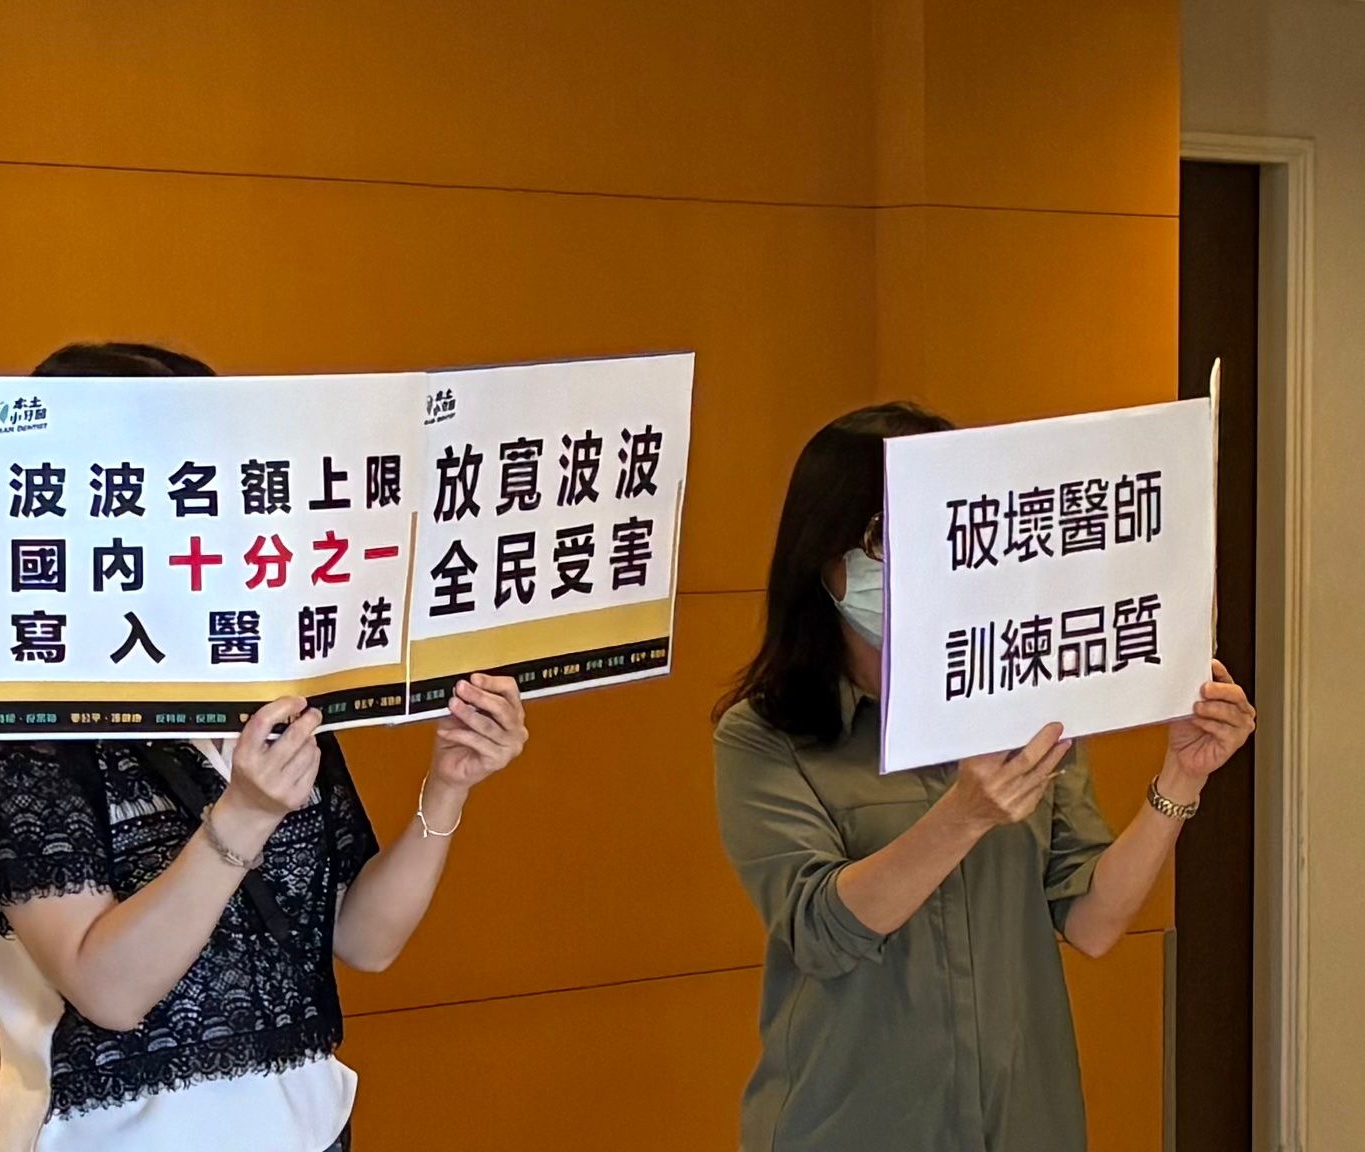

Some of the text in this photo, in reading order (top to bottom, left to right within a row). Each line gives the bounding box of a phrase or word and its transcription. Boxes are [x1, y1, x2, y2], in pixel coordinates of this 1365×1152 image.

[8, 453, 402, 519] 波波名額上限
[434, 424, 664, 525] 放寬波波
[945, 469, 1163, 572] 破壞醫師
[9, 529, 401, 593] 國內十分之一
[429, 515, 655, 620] 全民受害
[10, 596, 391, 666] 寫入醫師法
[944, 592, 1162, 702] 訓練品質
